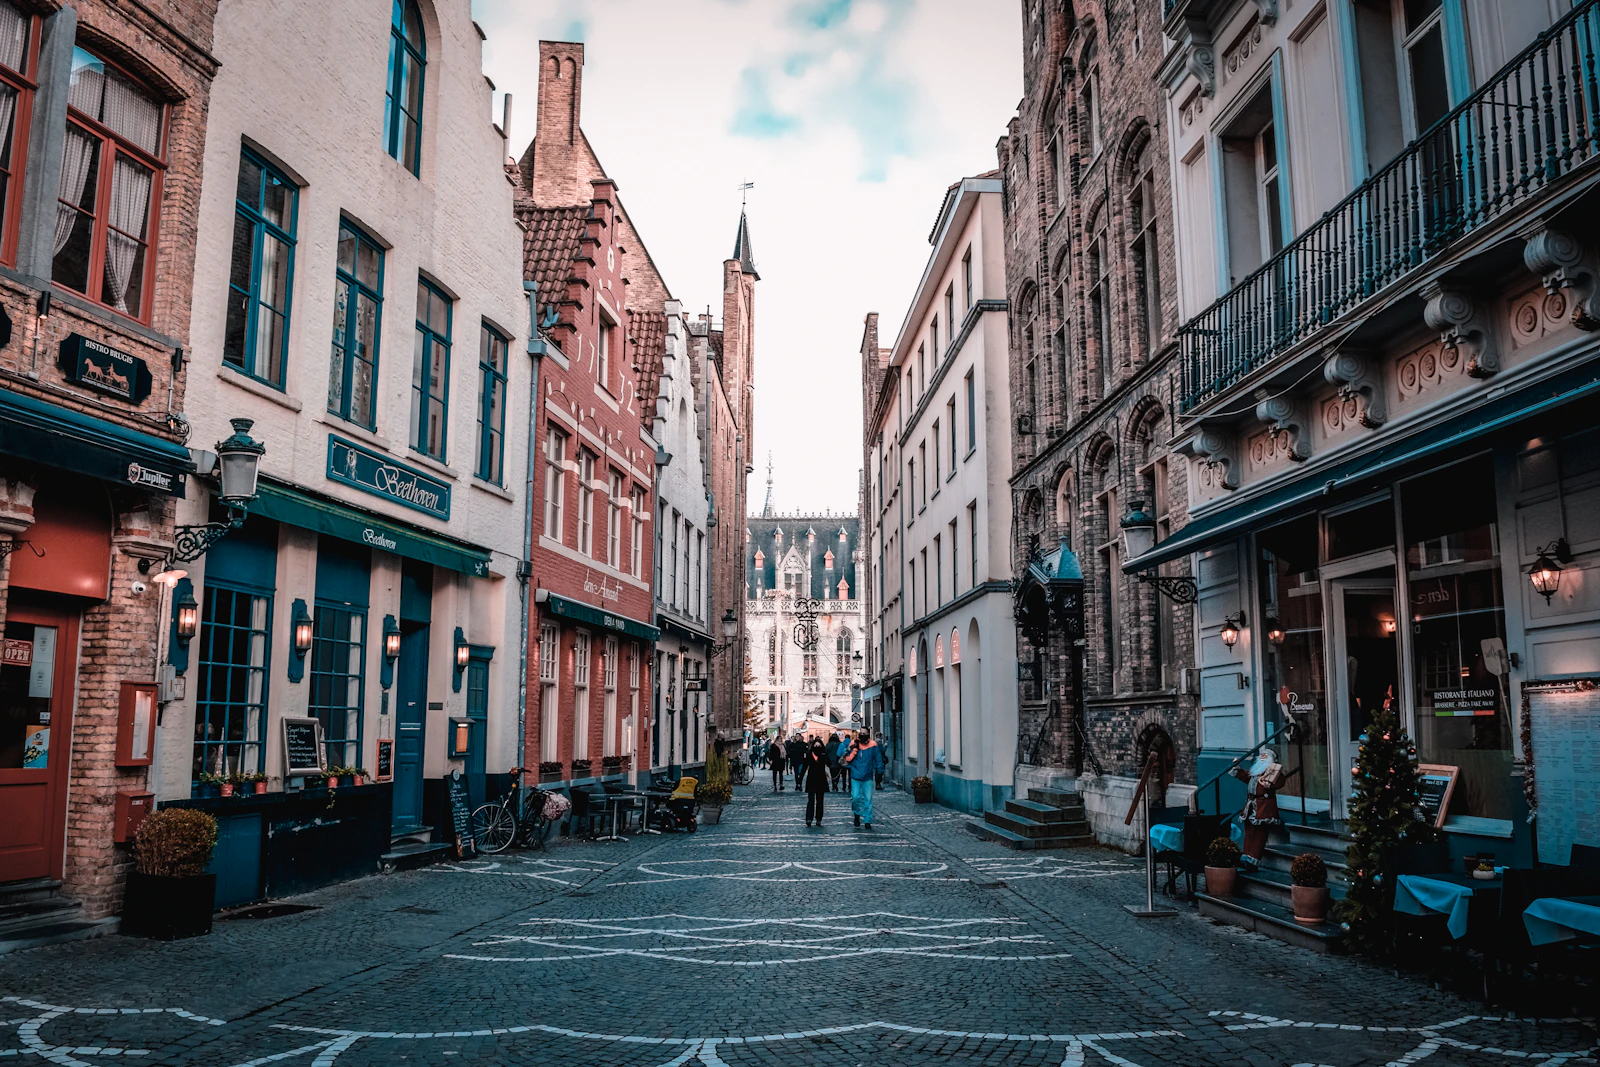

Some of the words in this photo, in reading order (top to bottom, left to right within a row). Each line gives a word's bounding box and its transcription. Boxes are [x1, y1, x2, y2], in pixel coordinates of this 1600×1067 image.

[85, 339, 109, 355] BISTRO
[110, 346, 134, 365] BRUGIS
[140, 470, 171, 486] Jupiler
[375, 462, 438, 510] Beethoven
[362, 528, 397, 550] Beethoven
[584, 568, 593, 593] den
[593, 574, 623, 602] Amand
[5, 648, 30, 660] OPEN
[1287, 692, 1314, 712] Benvenuto
[1434, 690, 1467, 700] RISTORANTE
[1467, 688, 1495, 698] ITALIANO
[1434, 701, 1455, 709] BRASSERIE
